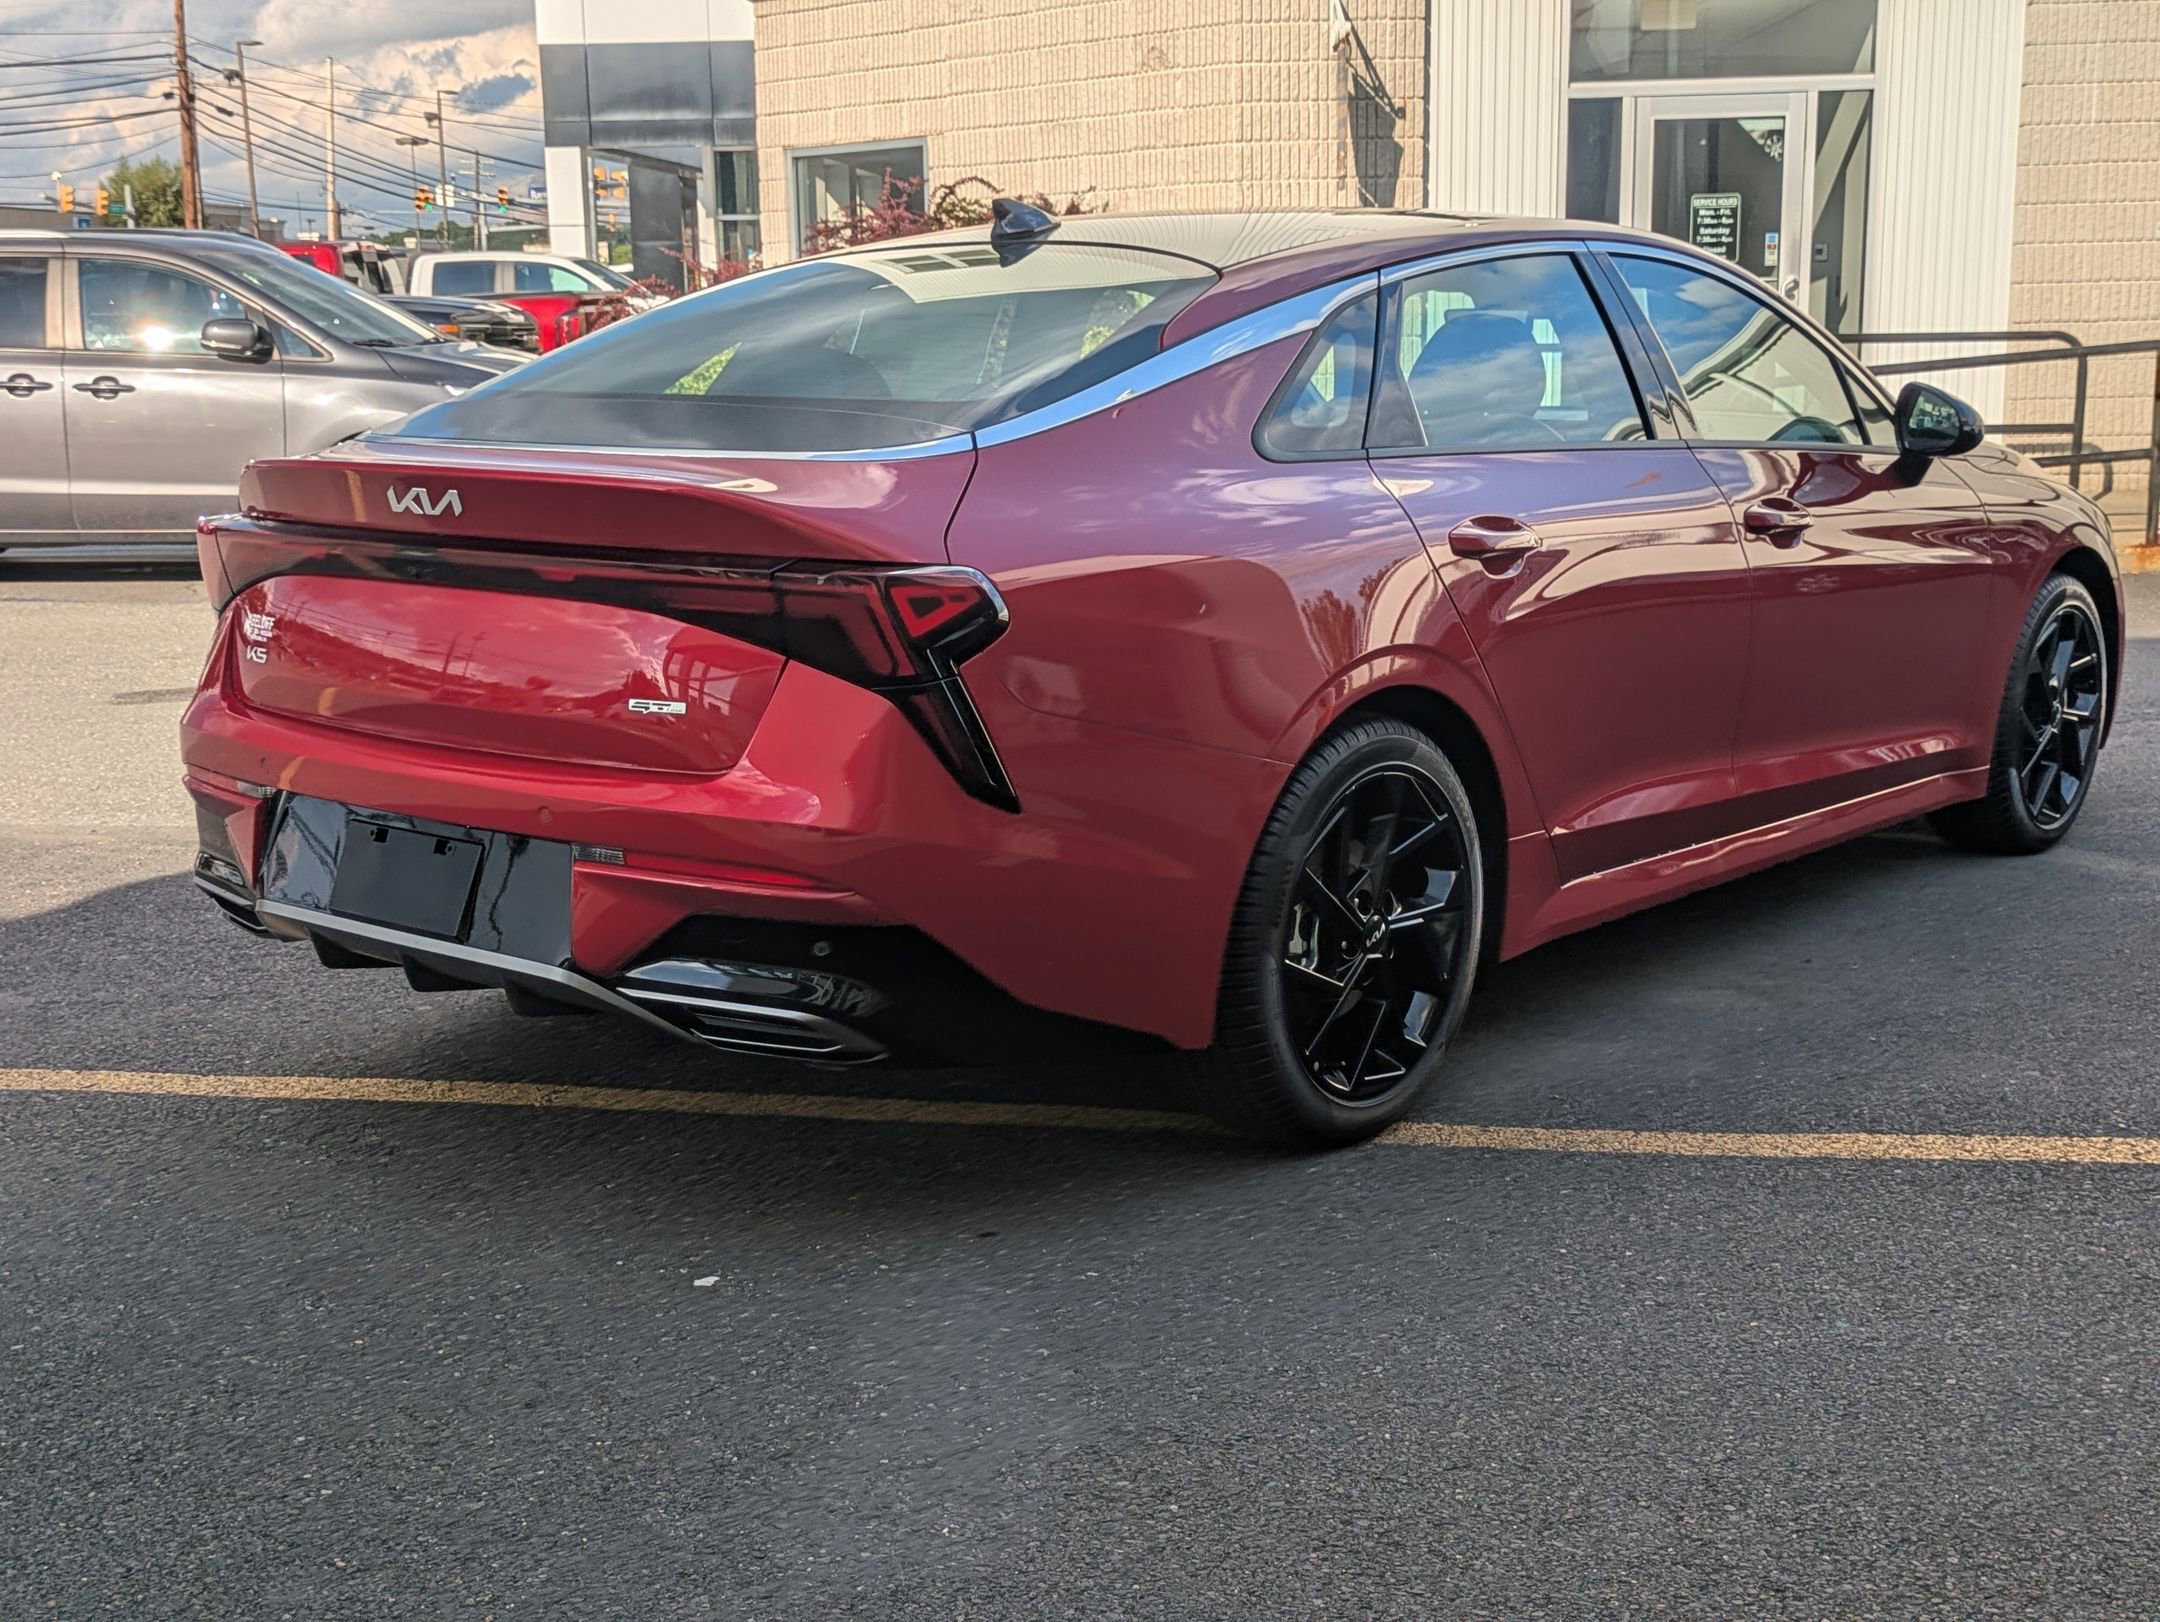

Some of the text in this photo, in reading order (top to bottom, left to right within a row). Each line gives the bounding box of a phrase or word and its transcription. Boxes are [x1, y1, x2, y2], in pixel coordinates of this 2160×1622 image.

[1693, 197, 1738, 207] SERVICE HOURS
[387, 485, 463, 517] KIA
[246, 645, 268, 664] K5
